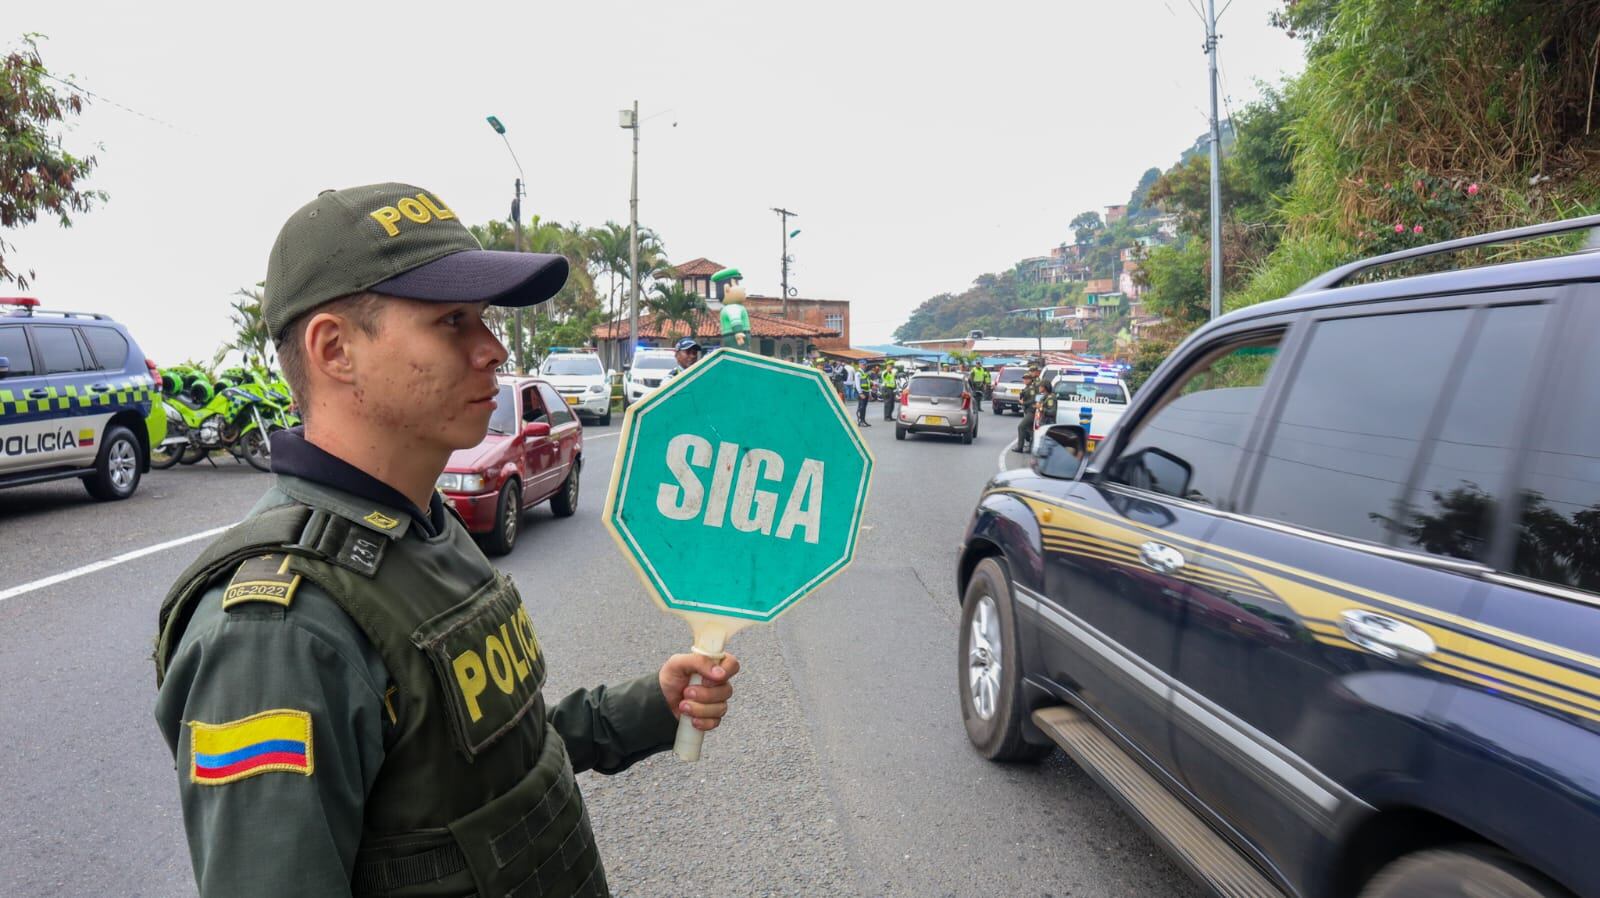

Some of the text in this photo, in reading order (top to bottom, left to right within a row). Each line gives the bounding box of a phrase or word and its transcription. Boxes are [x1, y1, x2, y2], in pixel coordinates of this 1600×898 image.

[369, 193, 455, 237] POL
[0, 426, 77, 456] OLICÍA
[656, 433, 825, 544] SIGA
[228, 585, 285, 598] 06-2022
